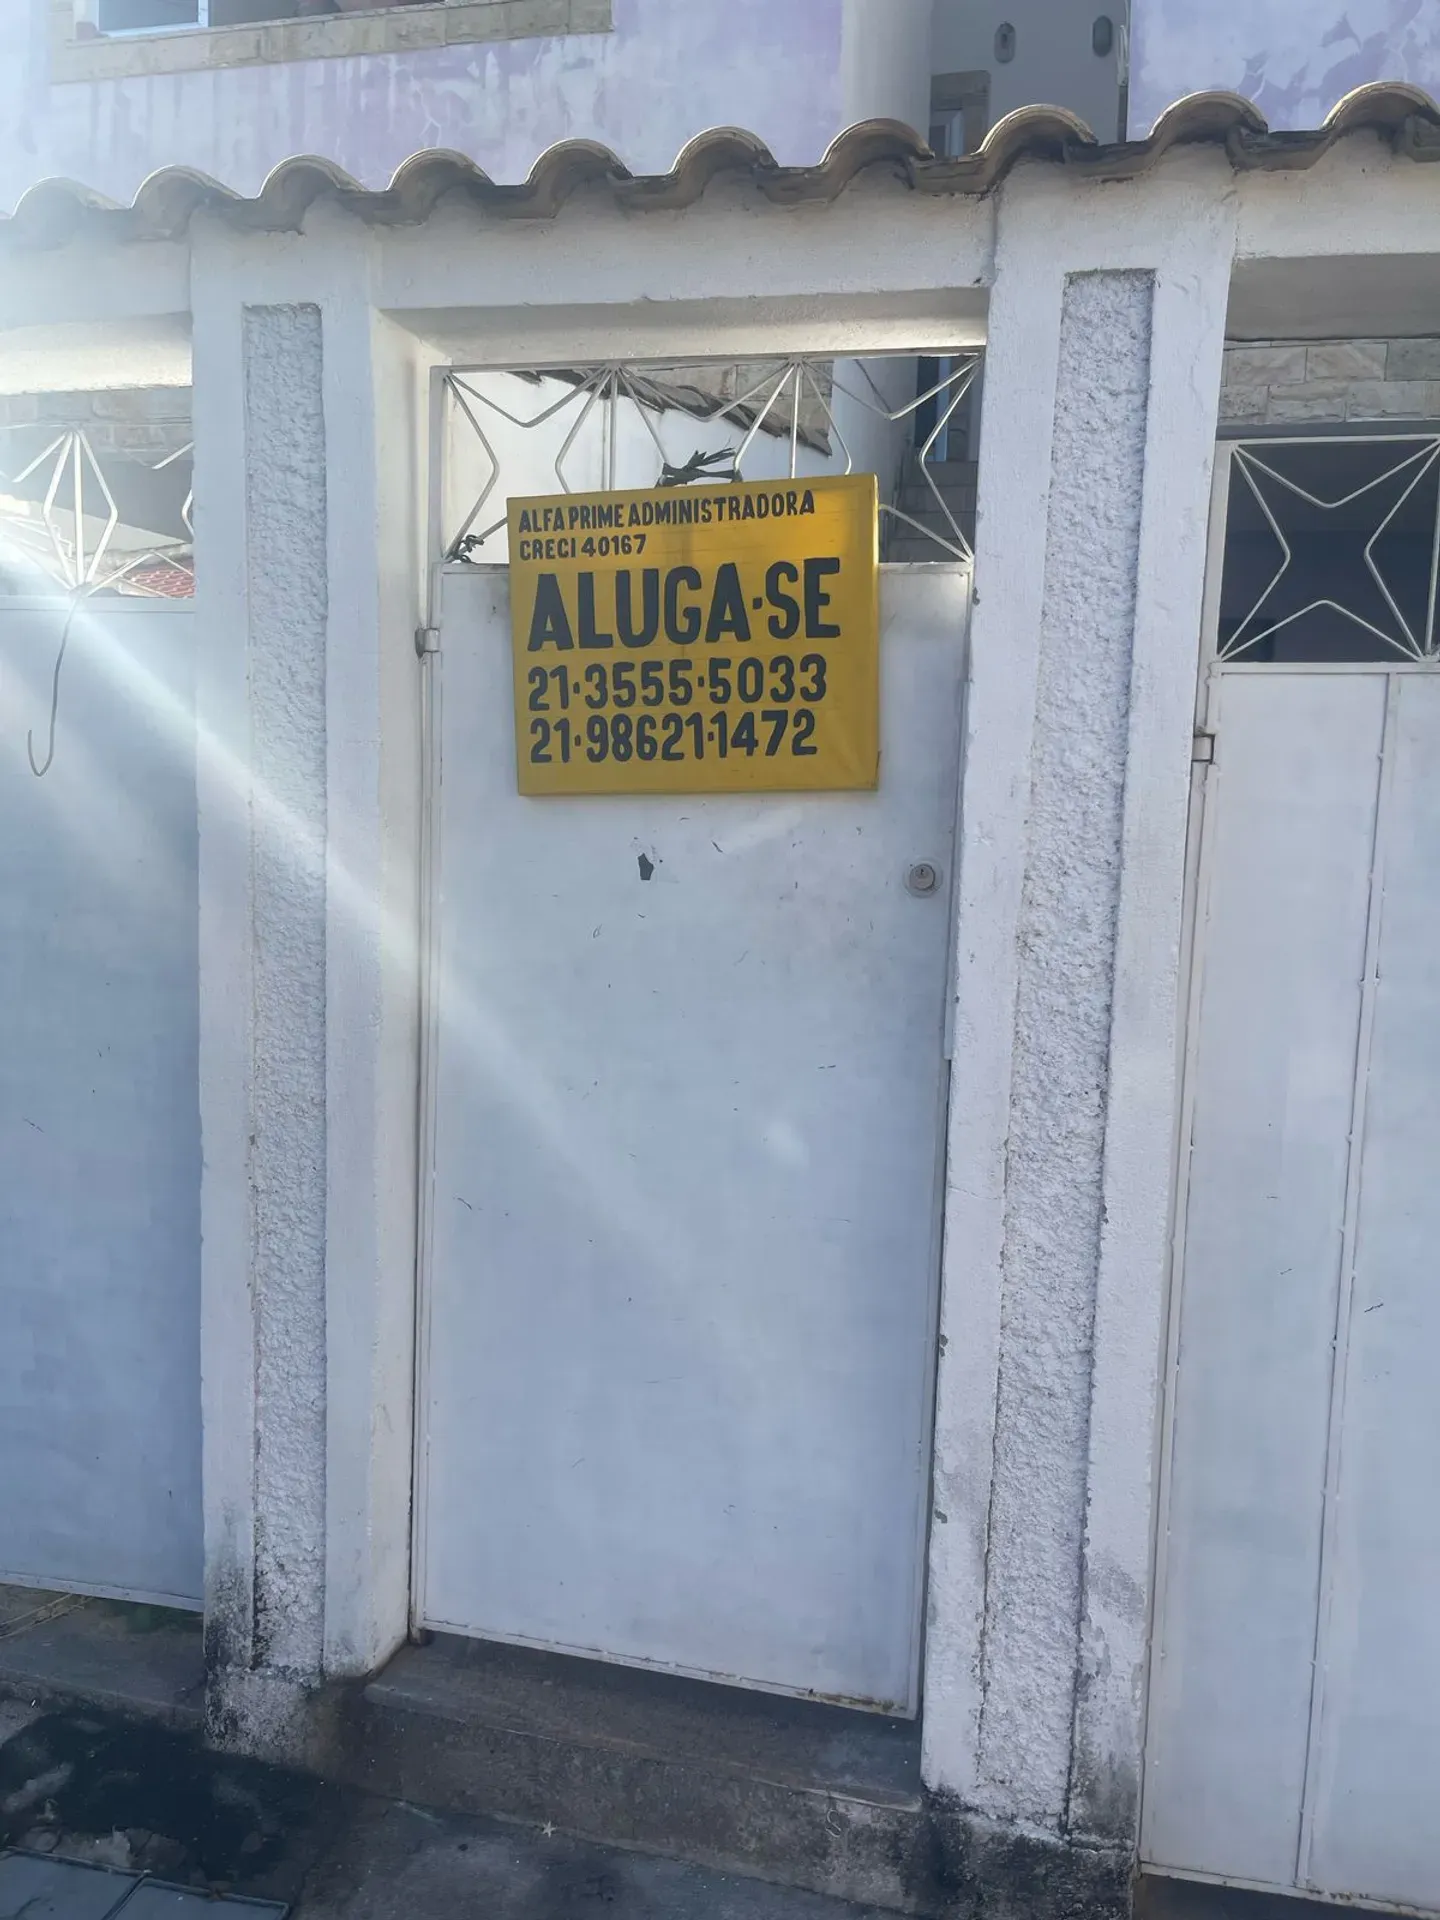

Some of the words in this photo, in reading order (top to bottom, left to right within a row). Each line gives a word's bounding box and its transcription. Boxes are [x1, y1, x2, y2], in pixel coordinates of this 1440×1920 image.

[518, 506, 565, 533] ALFA
[568, 503, 625, 531] PRIME
[628, 489, 815, 528] ADMINISTRADORA
[519, 537, 577, 561] CRECI
[581, 533, 647, 557] 40167
